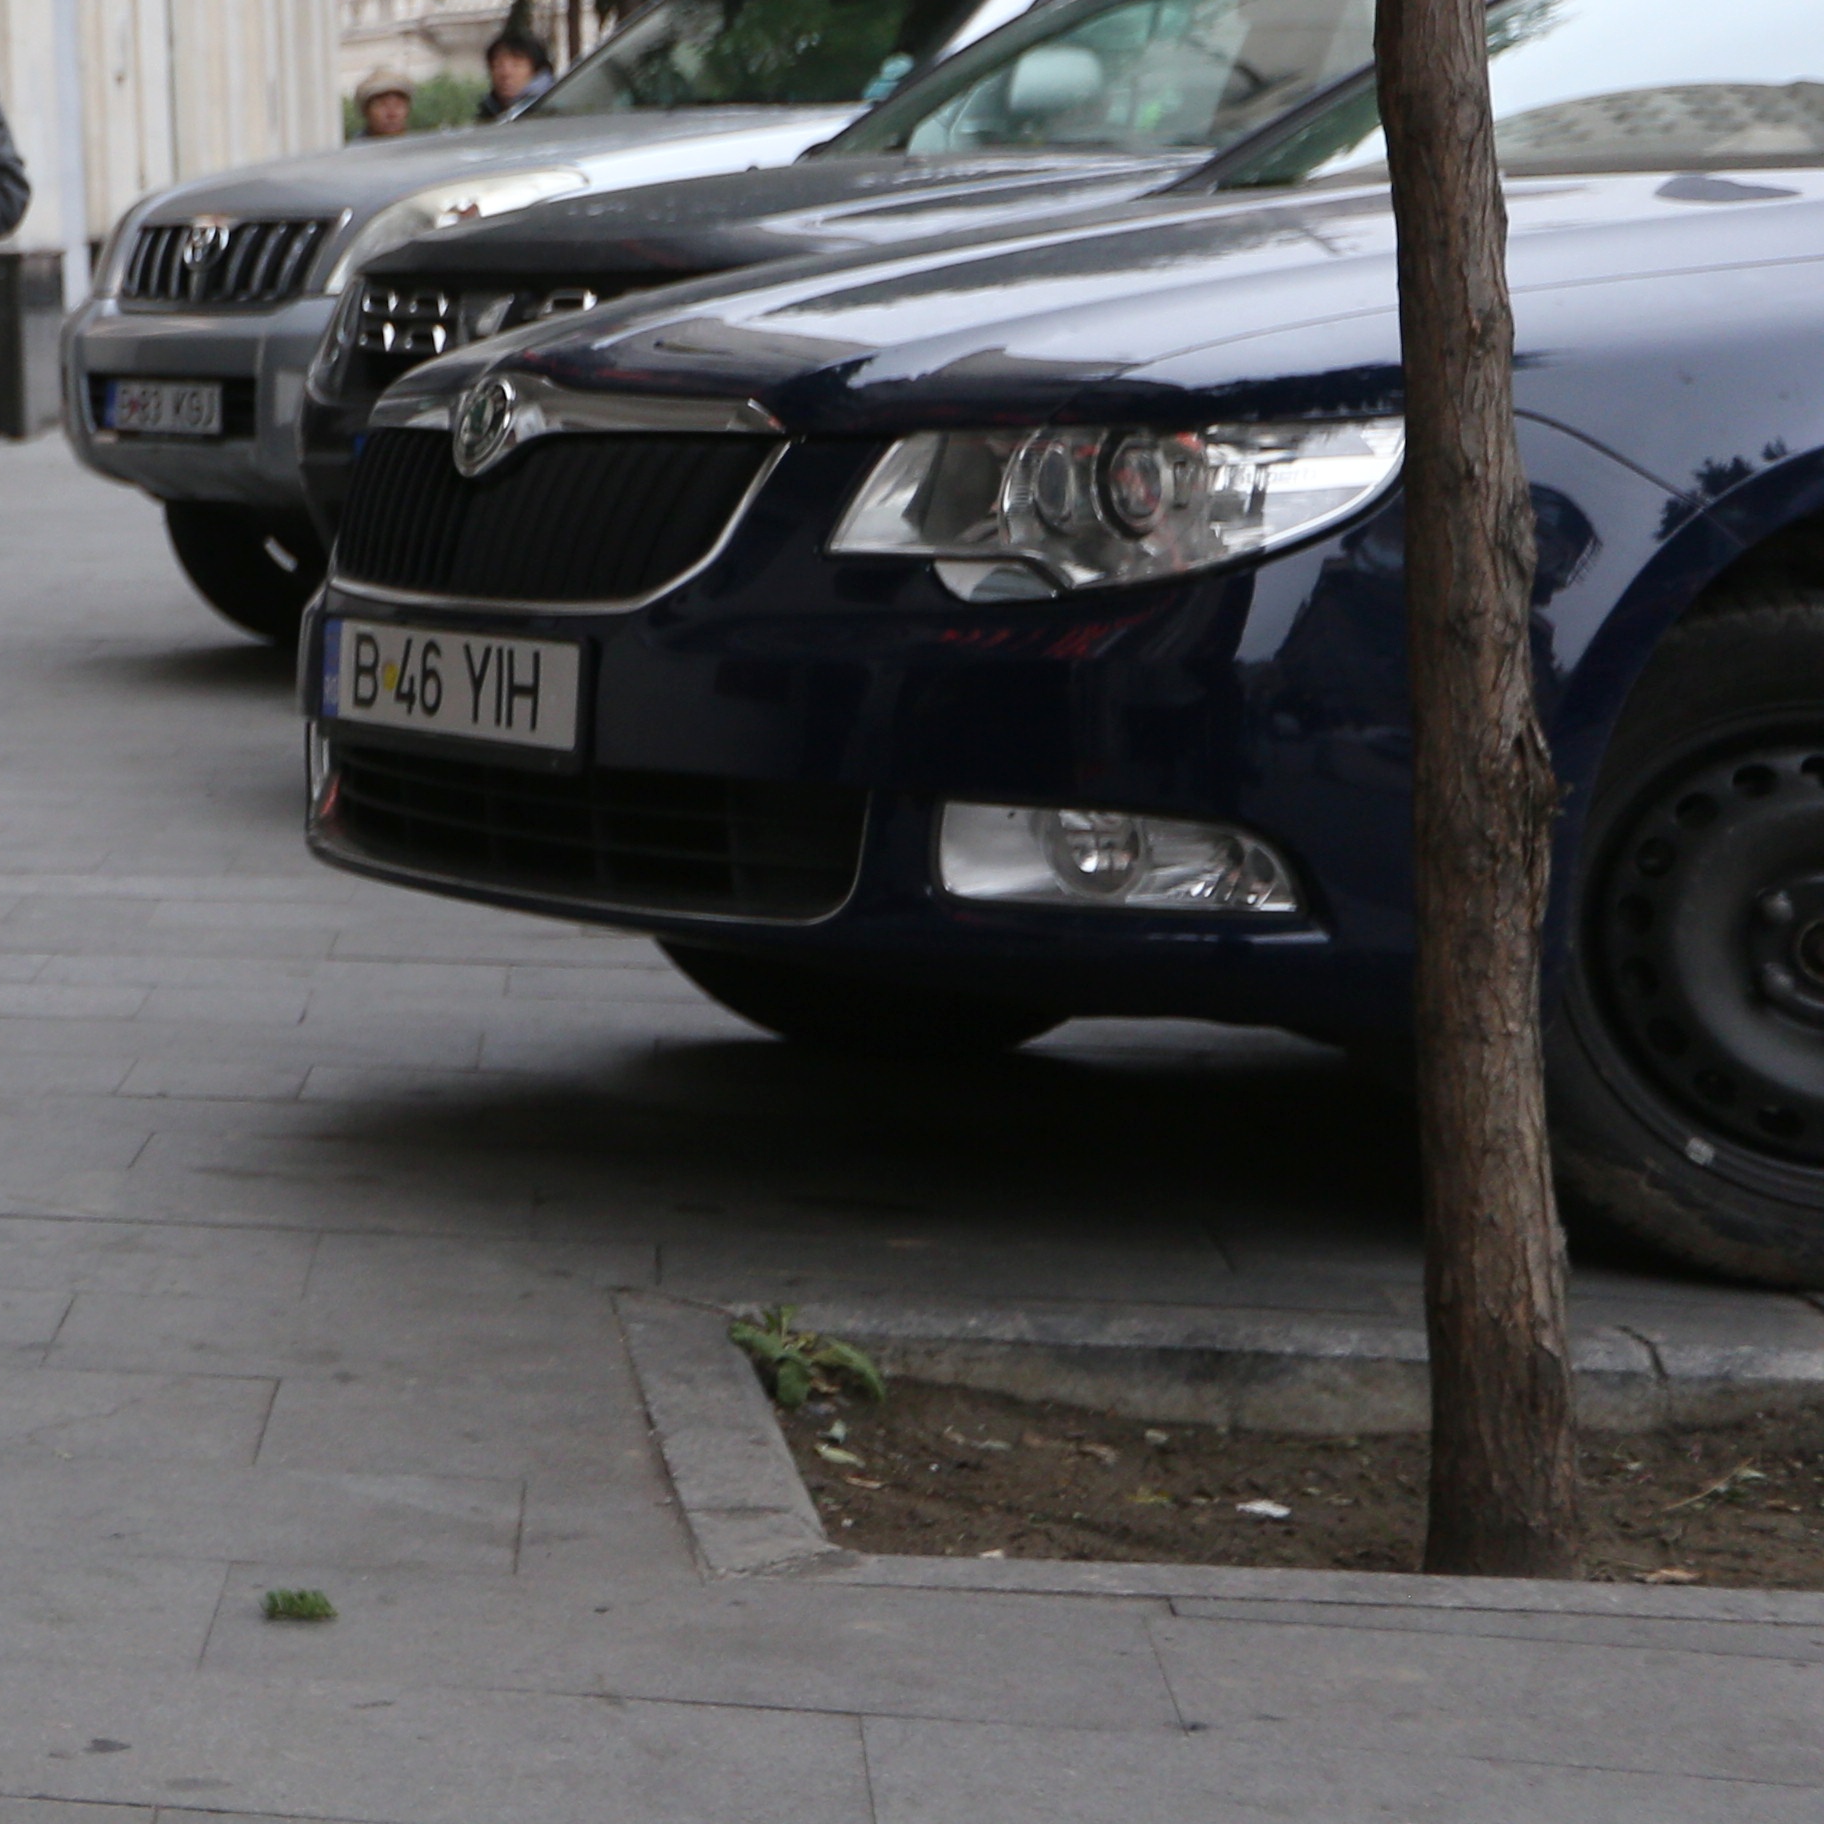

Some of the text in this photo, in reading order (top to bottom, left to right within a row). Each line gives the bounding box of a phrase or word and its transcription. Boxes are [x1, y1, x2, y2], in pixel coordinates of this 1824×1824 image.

[353, 632, 380, 708] B
[394, 637, 443, 718] 46
[463, 642, 542, 732] YIH
